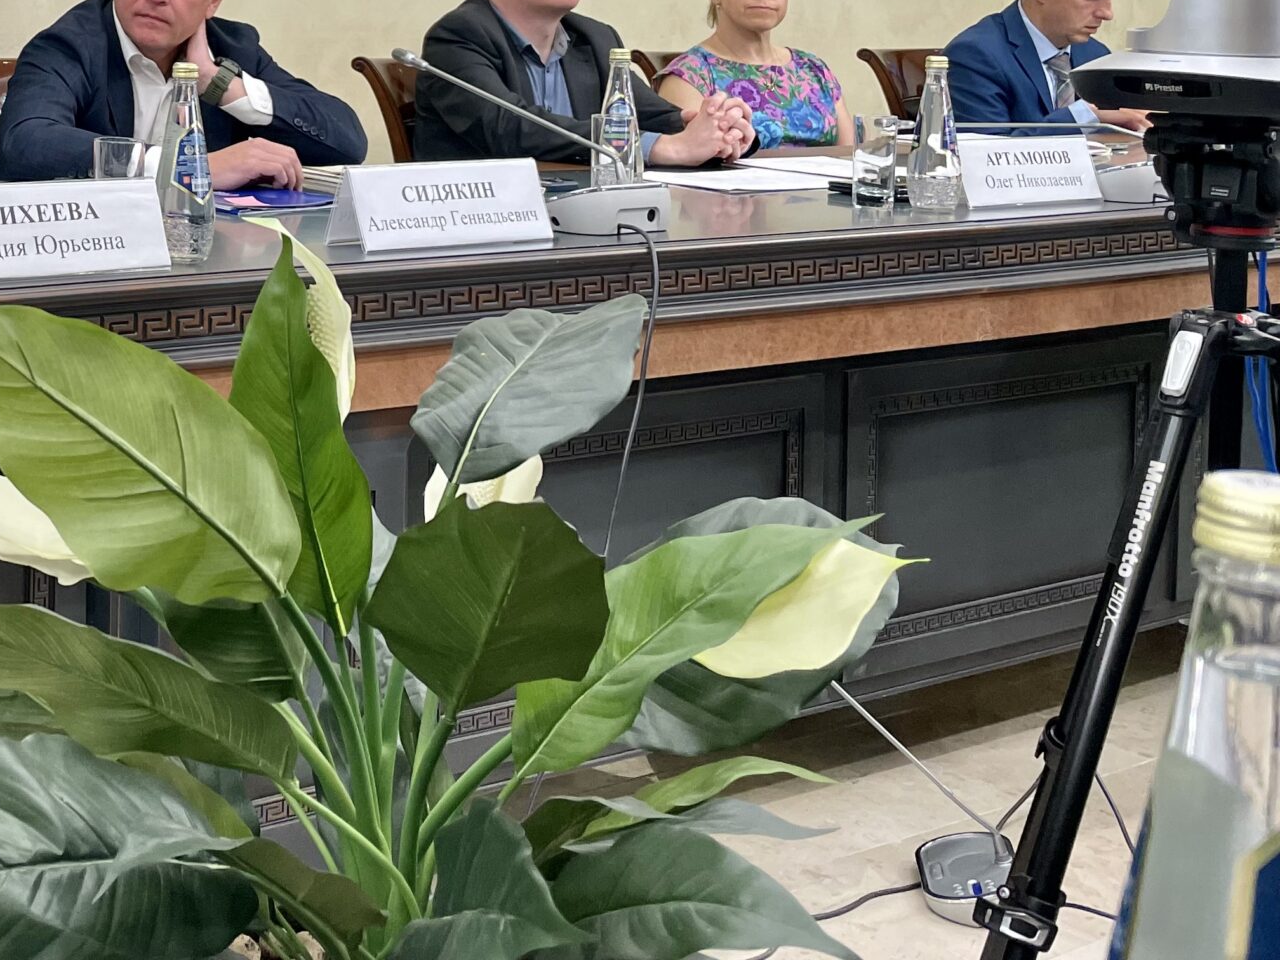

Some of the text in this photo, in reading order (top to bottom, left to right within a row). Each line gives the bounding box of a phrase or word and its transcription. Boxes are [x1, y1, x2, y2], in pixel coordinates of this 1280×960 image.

[986, 150, 1071, 167] АРТАМОНОВ
[401, 181, 496, 204] СИДЯКИН
[985, 173, 1083, 189] Олег Николаевич
[368, 209, 539, 233] Александр Геннадьевич
[32, 234, 126, 259] Юрьевна
[1118, 460, 1166, 577] Manfrotto
